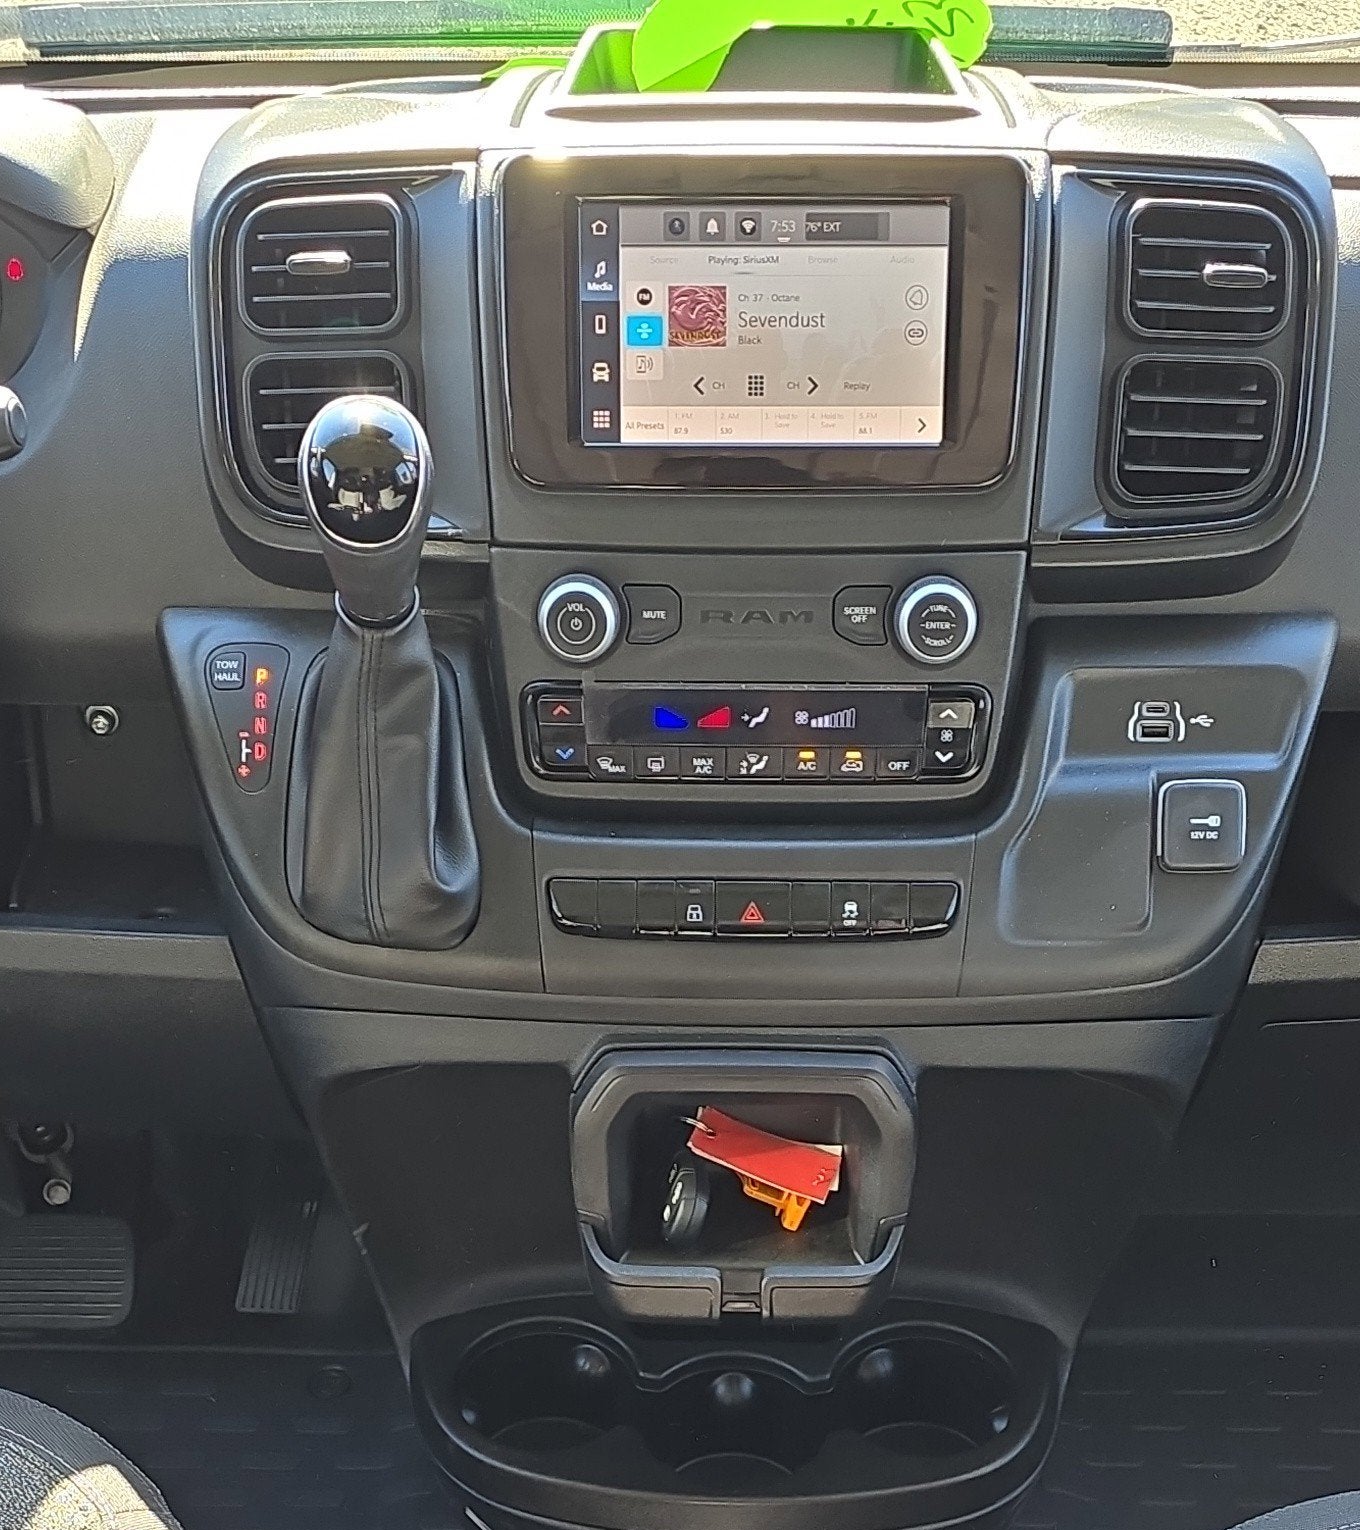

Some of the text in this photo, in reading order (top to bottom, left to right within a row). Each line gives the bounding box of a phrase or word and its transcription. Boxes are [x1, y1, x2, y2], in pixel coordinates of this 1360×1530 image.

[771, 220, 795, 232] 7:53
[823, 221, 841, 232] EXT
[650, 256, 680, 264] Source
[708, 255, 779, 266] Playing: SiriusXM
[808, 255, 838, 264] Browse
[890, 255, 915, 264] Audio
[587, 282, 613, 291] Media
[738, 293, 800, 302] Ch 37 Octane
[738, 311, 825, 328] Sevendust
[738, 335, 762, 345] Black
[712, 381, 726, 390] CH
[787, 381, 800, 390] CH
[843, 381, 871, 392] Replay
[625, 421, 665, 430] All Presets
[567, 602, 586, 613] VOL
[843, 605, 877, 615] SCREEN
[929, 603, 949, 613] TUNE
[642, 610, 667, 620] MUTE
[700, 609, 814, 625] RAM
[851, 614, 868, 624] OFF
[925, 620, 952, 631] ENTER
[215, 660, 239, 669] TOW
[214, 672, 241, 682] HAUL
[255, 667, 268, 687] P
[254, 691, 267, 709] R
[254, 716, 267, 735] N
[254, 741, 267, 761] D
[693, 757, 714, 766] MAX
[797, 761, 817, 771] A/C
[888, 761, 911, 771] OFF
[608, 764, 627, 773] MAX
[695, 766, 713, 775] A/C
[1190, 831, 1219, 839] 12V DC
